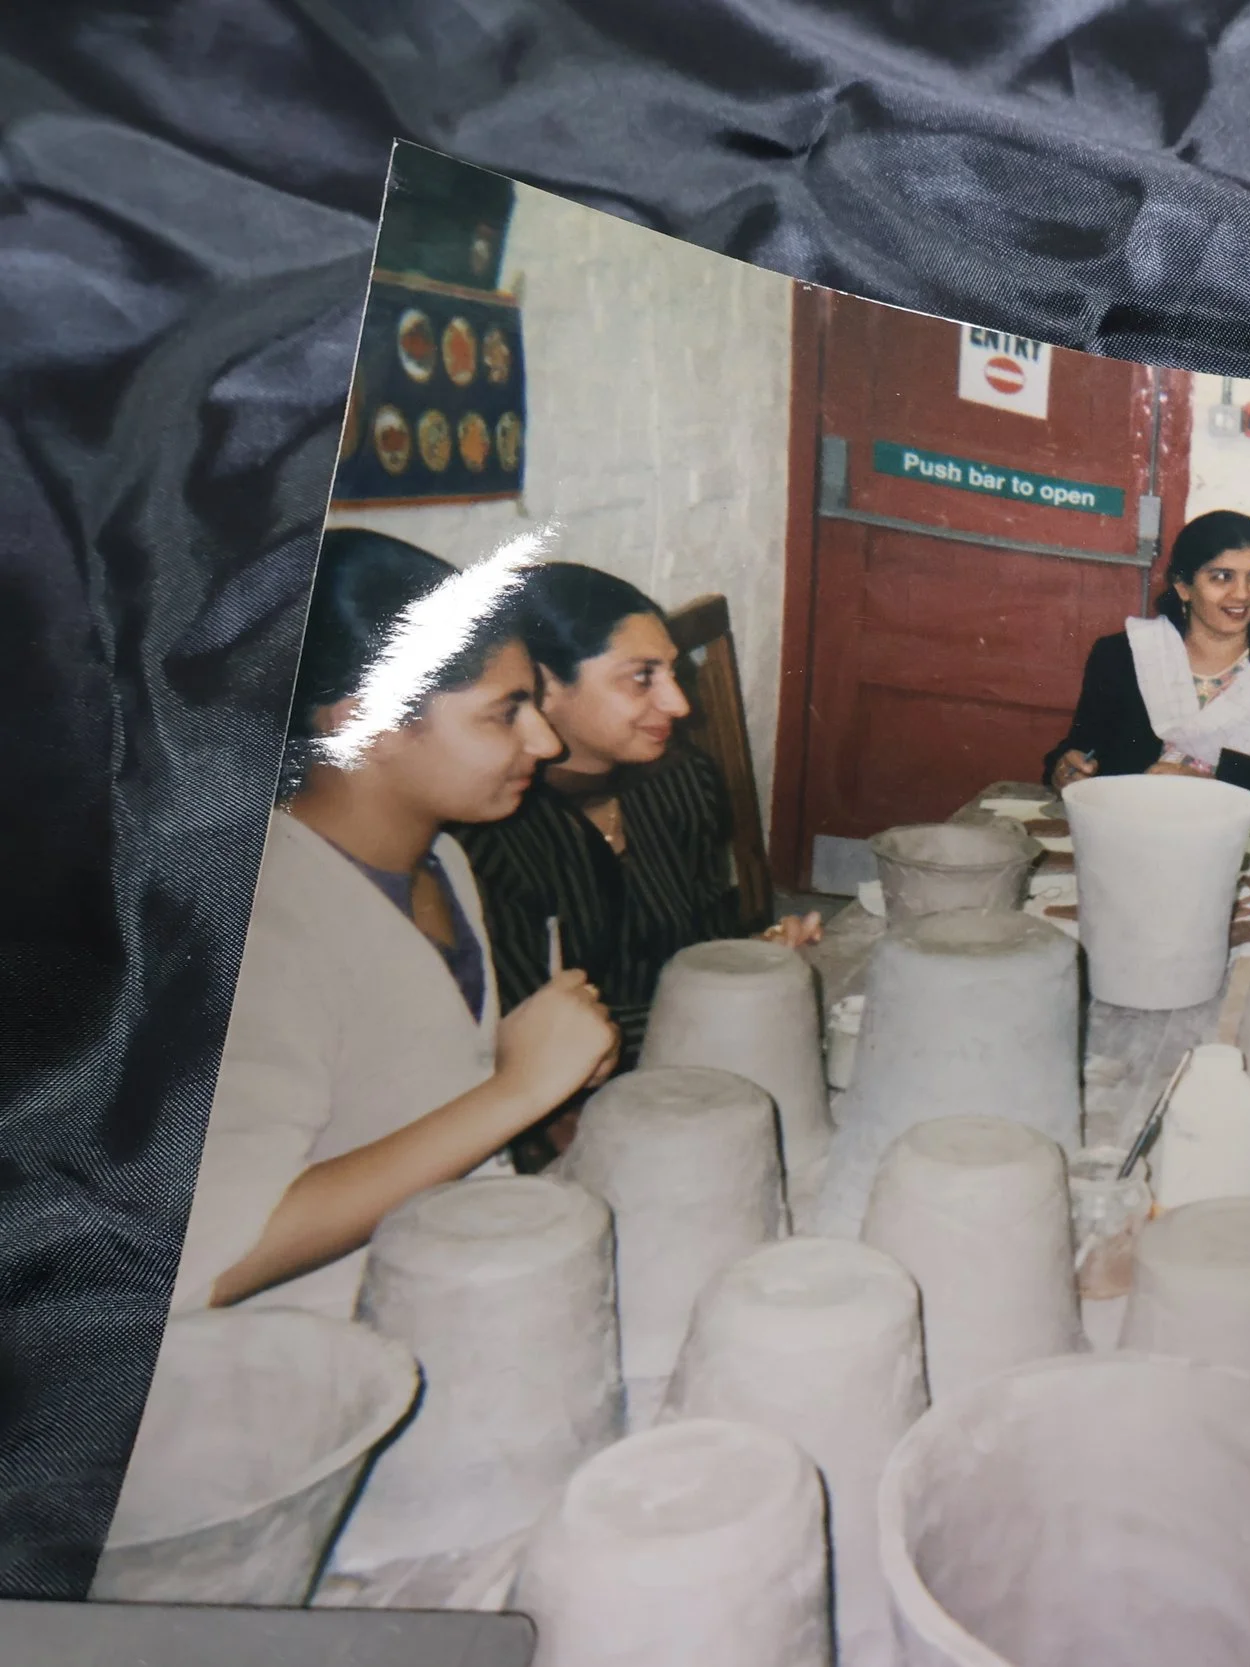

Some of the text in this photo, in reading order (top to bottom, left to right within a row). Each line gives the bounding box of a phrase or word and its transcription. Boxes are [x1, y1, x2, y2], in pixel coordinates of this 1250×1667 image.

[903, 452, 1096, 507] Push bar to open
